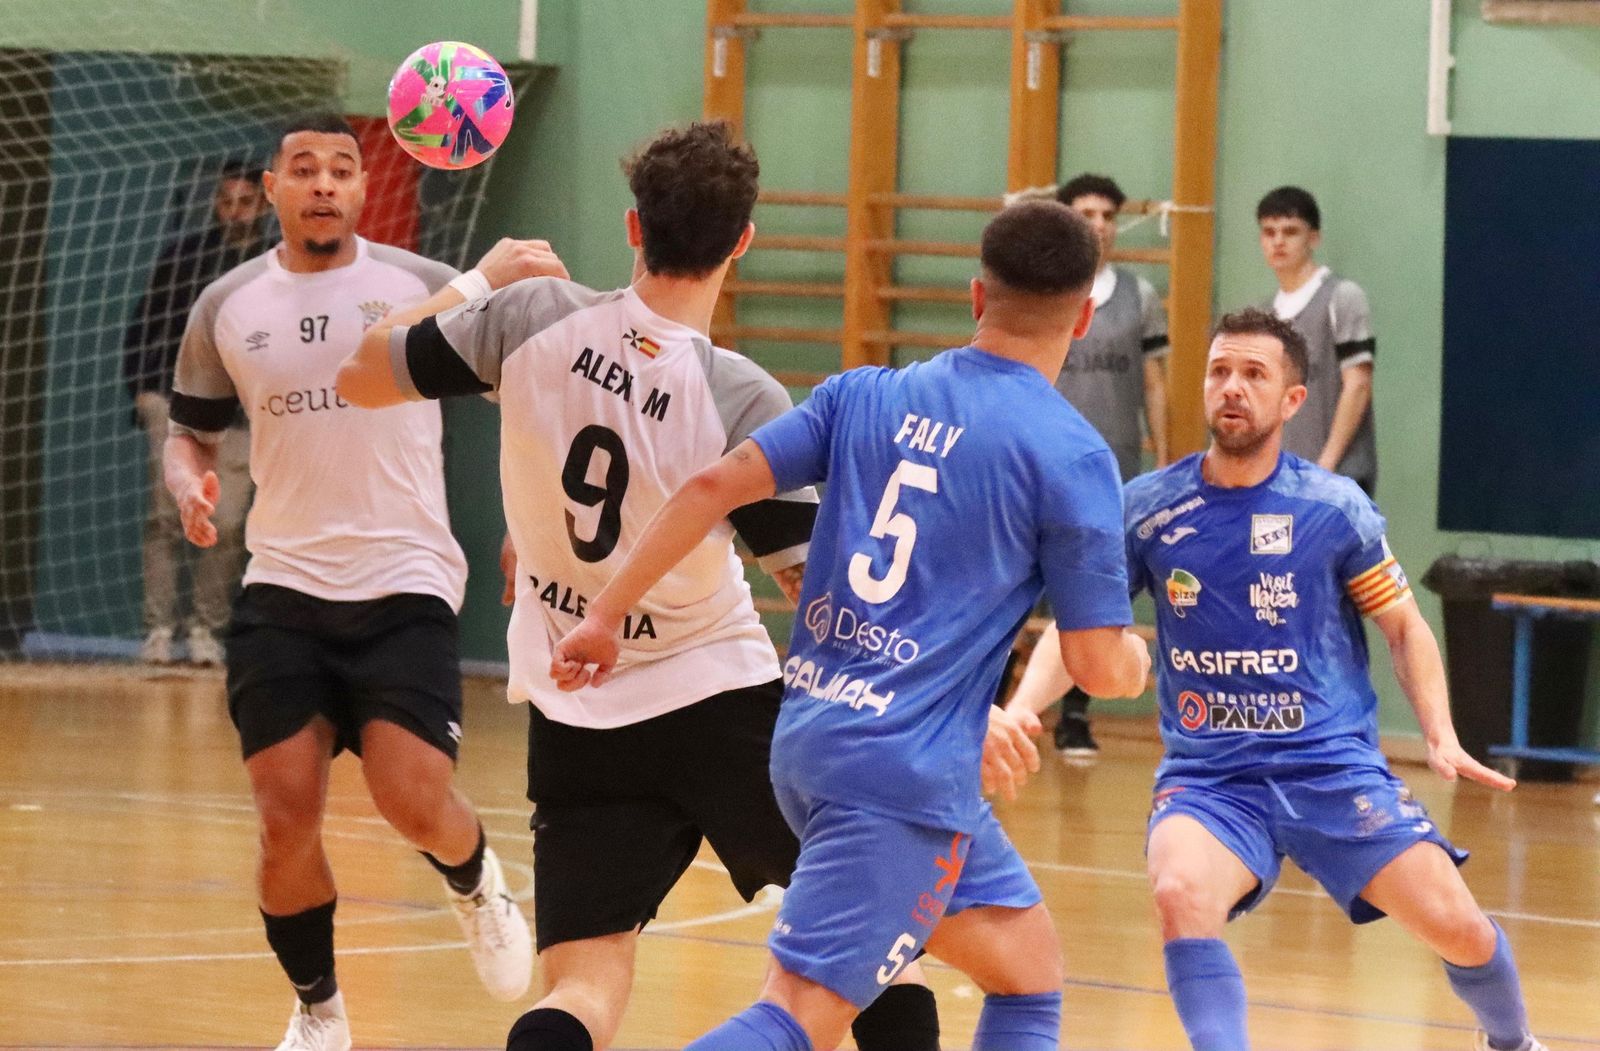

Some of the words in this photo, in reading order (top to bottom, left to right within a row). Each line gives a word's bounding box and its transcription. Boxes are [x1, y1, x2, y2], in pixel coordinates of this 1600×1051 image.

[300, 315, 330, 344] 97
[571, 347, 634, 402] ALEX
[641, 388, 671, 422] M
[894, 413, 964, 458] FALY
[562, 424, 629, 563] 9
[848, 459, 938, 605] 5
[529, 575, 657, 640] ALEIA
[835, 606, 919, 664] Desto
[1171, 647, 1299, 675] GASIFRED
[1209, 704, 1305, 733] PALAU
[876, 932, 917, 985] 5
